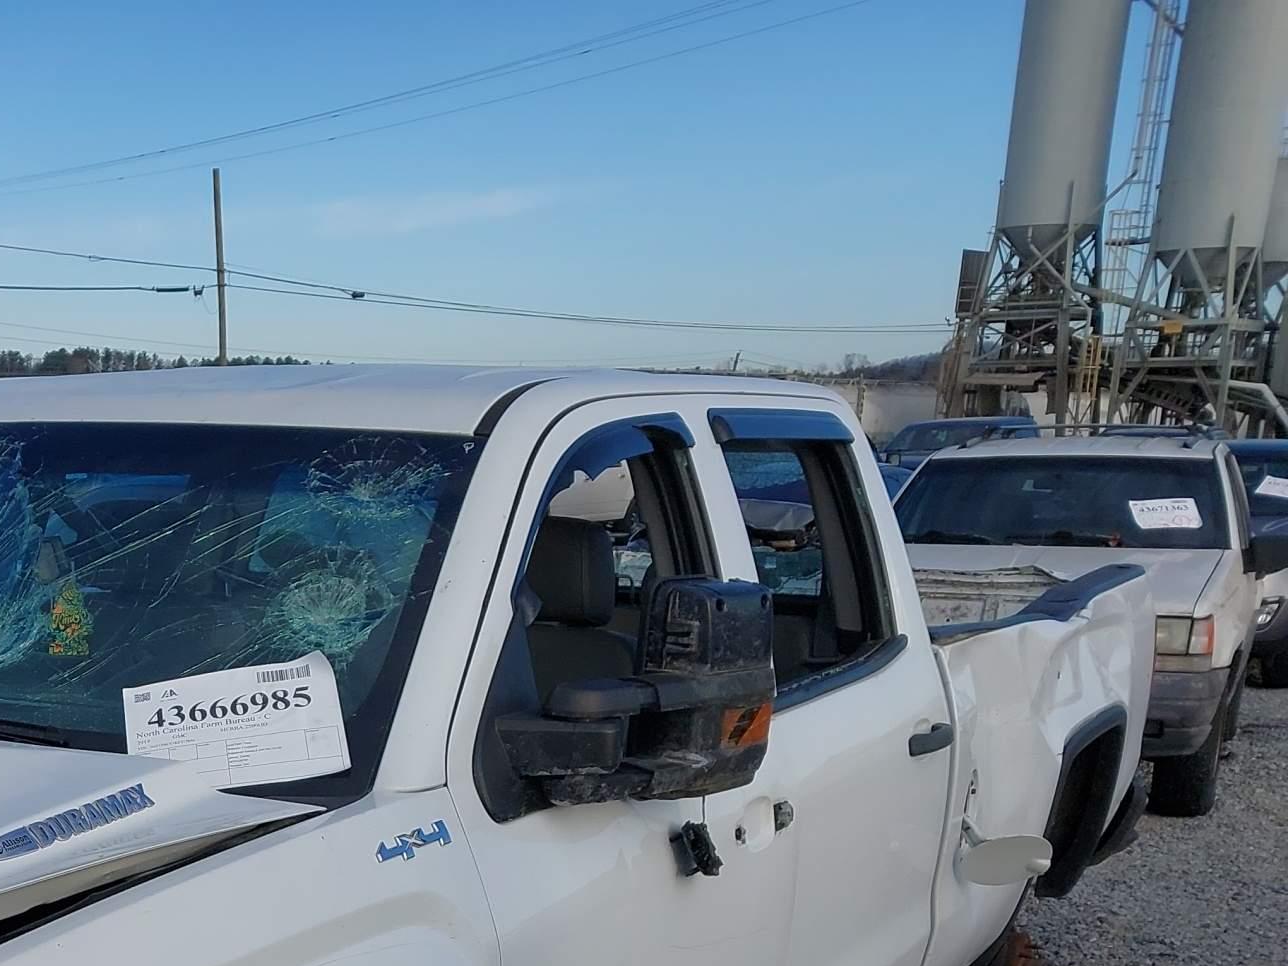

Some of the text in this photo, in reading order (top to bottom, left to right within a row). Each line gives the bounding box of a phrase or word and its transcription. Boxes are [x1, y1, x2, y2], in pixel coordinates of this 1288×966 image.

[136, 730, 161, 739] North
[162, 724, 199, 735] Carolina
[201, 720, 223, 729] Farm
[225, 715, 256, 725] Bureau
[147, 685, 312, 728] 43666985
[2, 783, 155, 849] Allison DURAMAX
